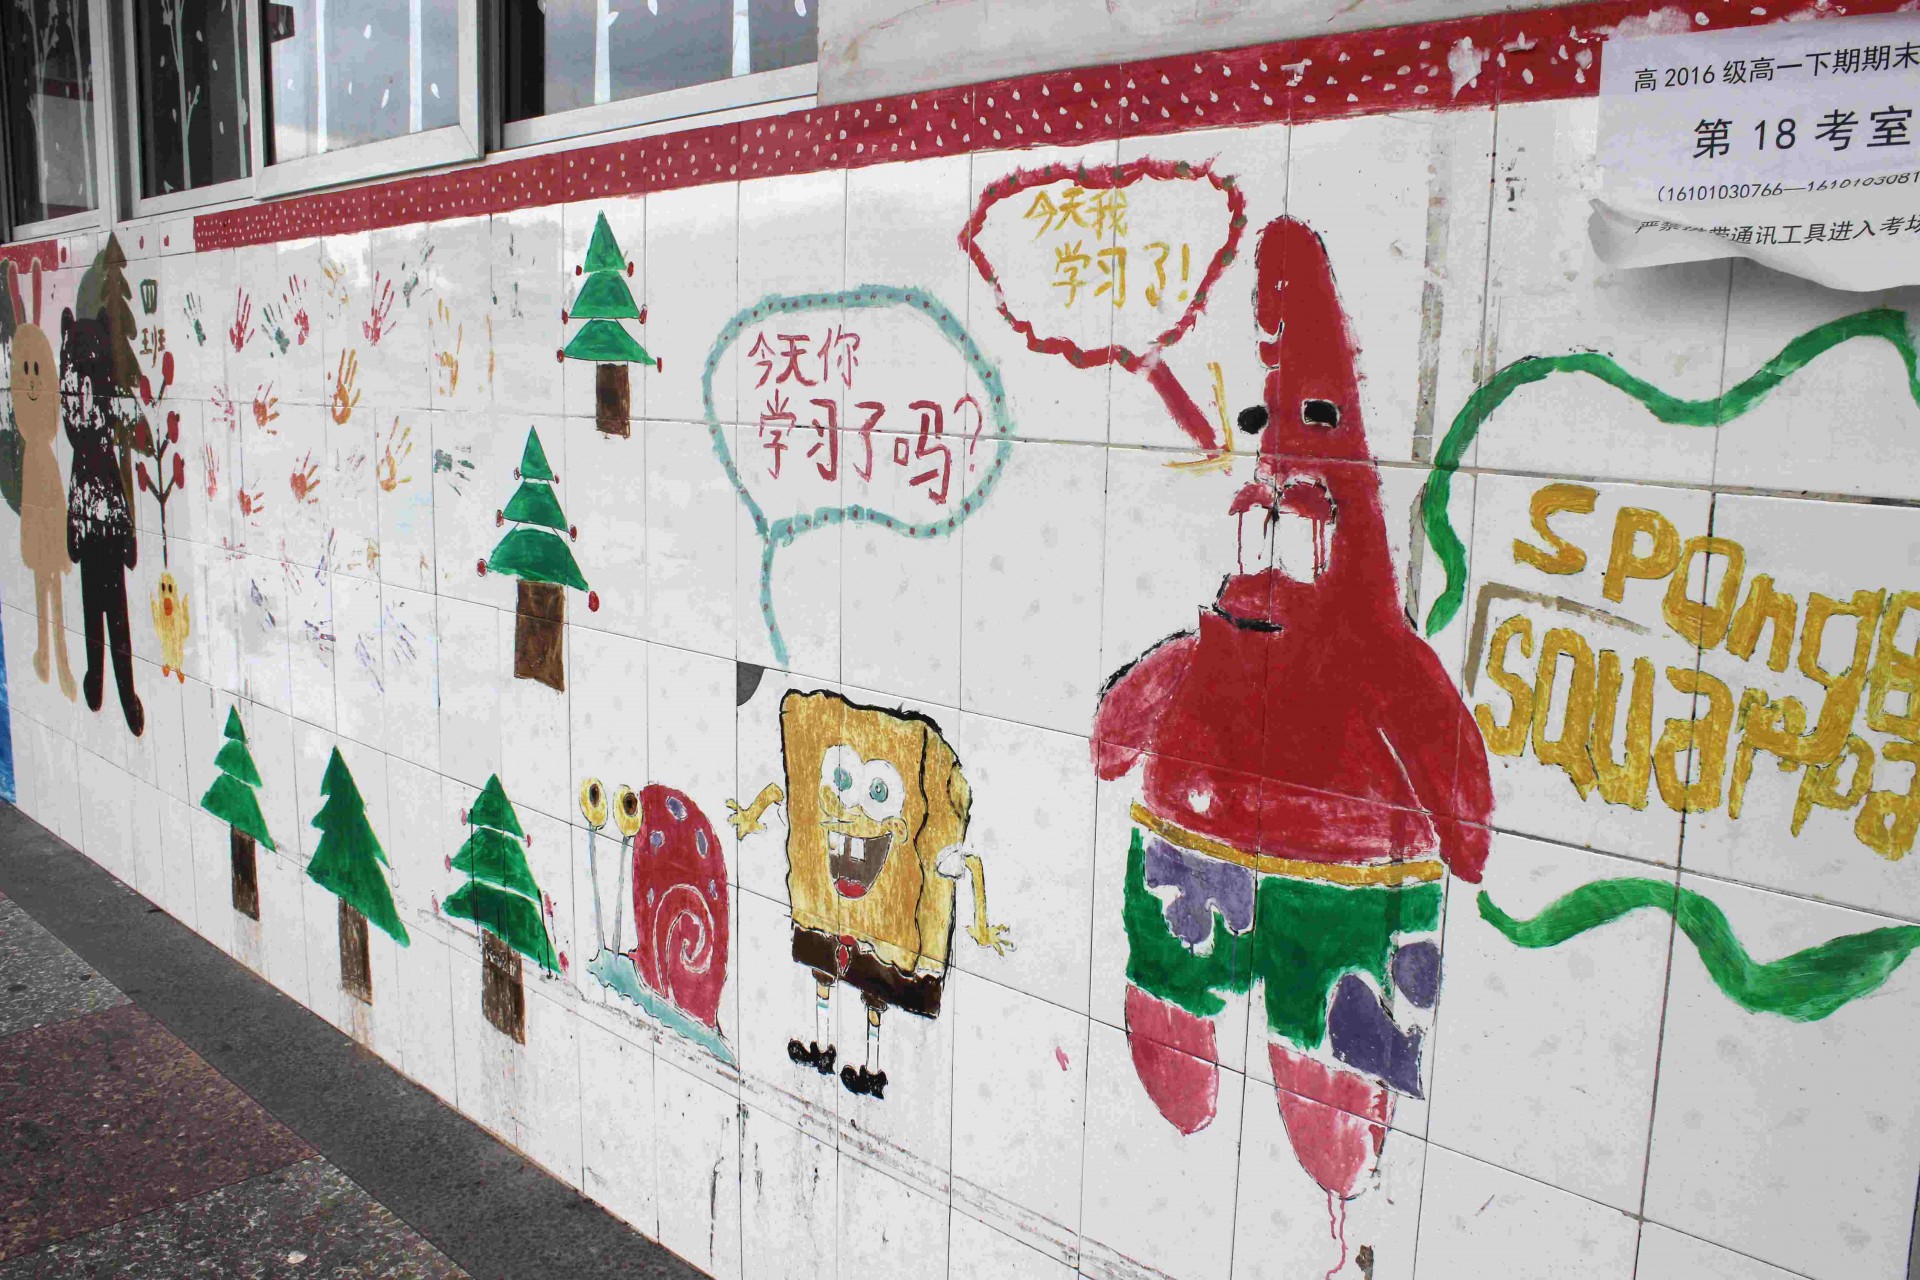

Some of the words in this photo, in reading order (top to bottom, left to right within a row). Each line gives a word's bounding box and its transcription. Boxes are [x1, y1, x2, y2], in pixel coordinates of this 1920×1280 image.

[1692, 118, 1733, 159] 第
[1754, 118, 1797, 151] 18
[1023, 186, 1129, 242] 今天我
[747, 324, 861, 390] 今天你
[758, 388, 983, 505] 学习了吗?
